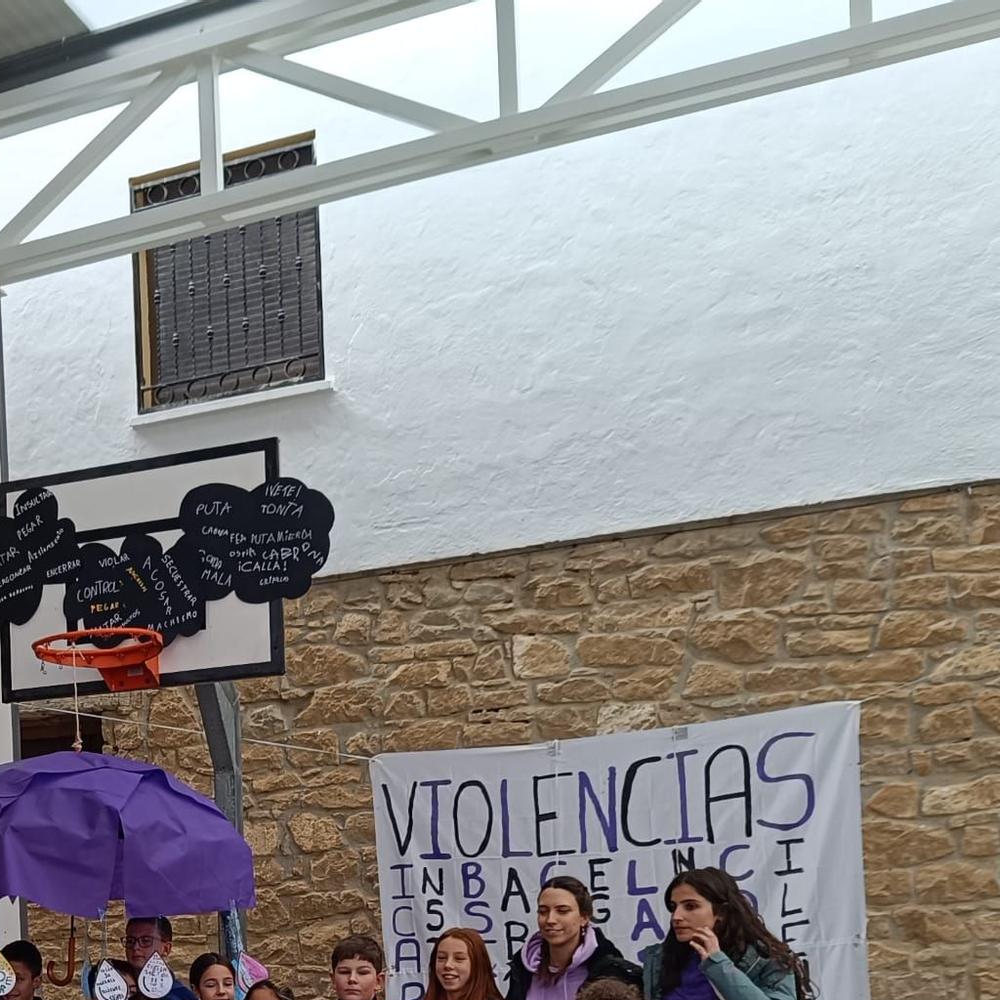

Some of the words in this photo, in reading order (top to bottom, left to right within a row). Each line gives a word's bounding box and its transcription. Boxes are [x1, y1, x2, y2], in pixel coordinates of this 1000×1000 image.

[195, 501, 232, 516] PUTA
[261, 500, 303, 518] TONTA
[16, 514, 44, 540] PEGAR
[98, 552, 131, 569] VIOLAR
[262, 541, 323, 566] CABRONA
[46, 559, 81, 578] ENCERRAR
[201, 569, 233, 588] MALA
[142, 555, 172, 616] ACOSAR
[161, 554, 198, 607] SECUESTRAR
[76, 580, 120, 603] CONTROL
[90, 602, 119, 614] PEGAR
[147, 610, 198, 631] MACHISMO
[382, 731, 816, 857] VIOLENCIAS
